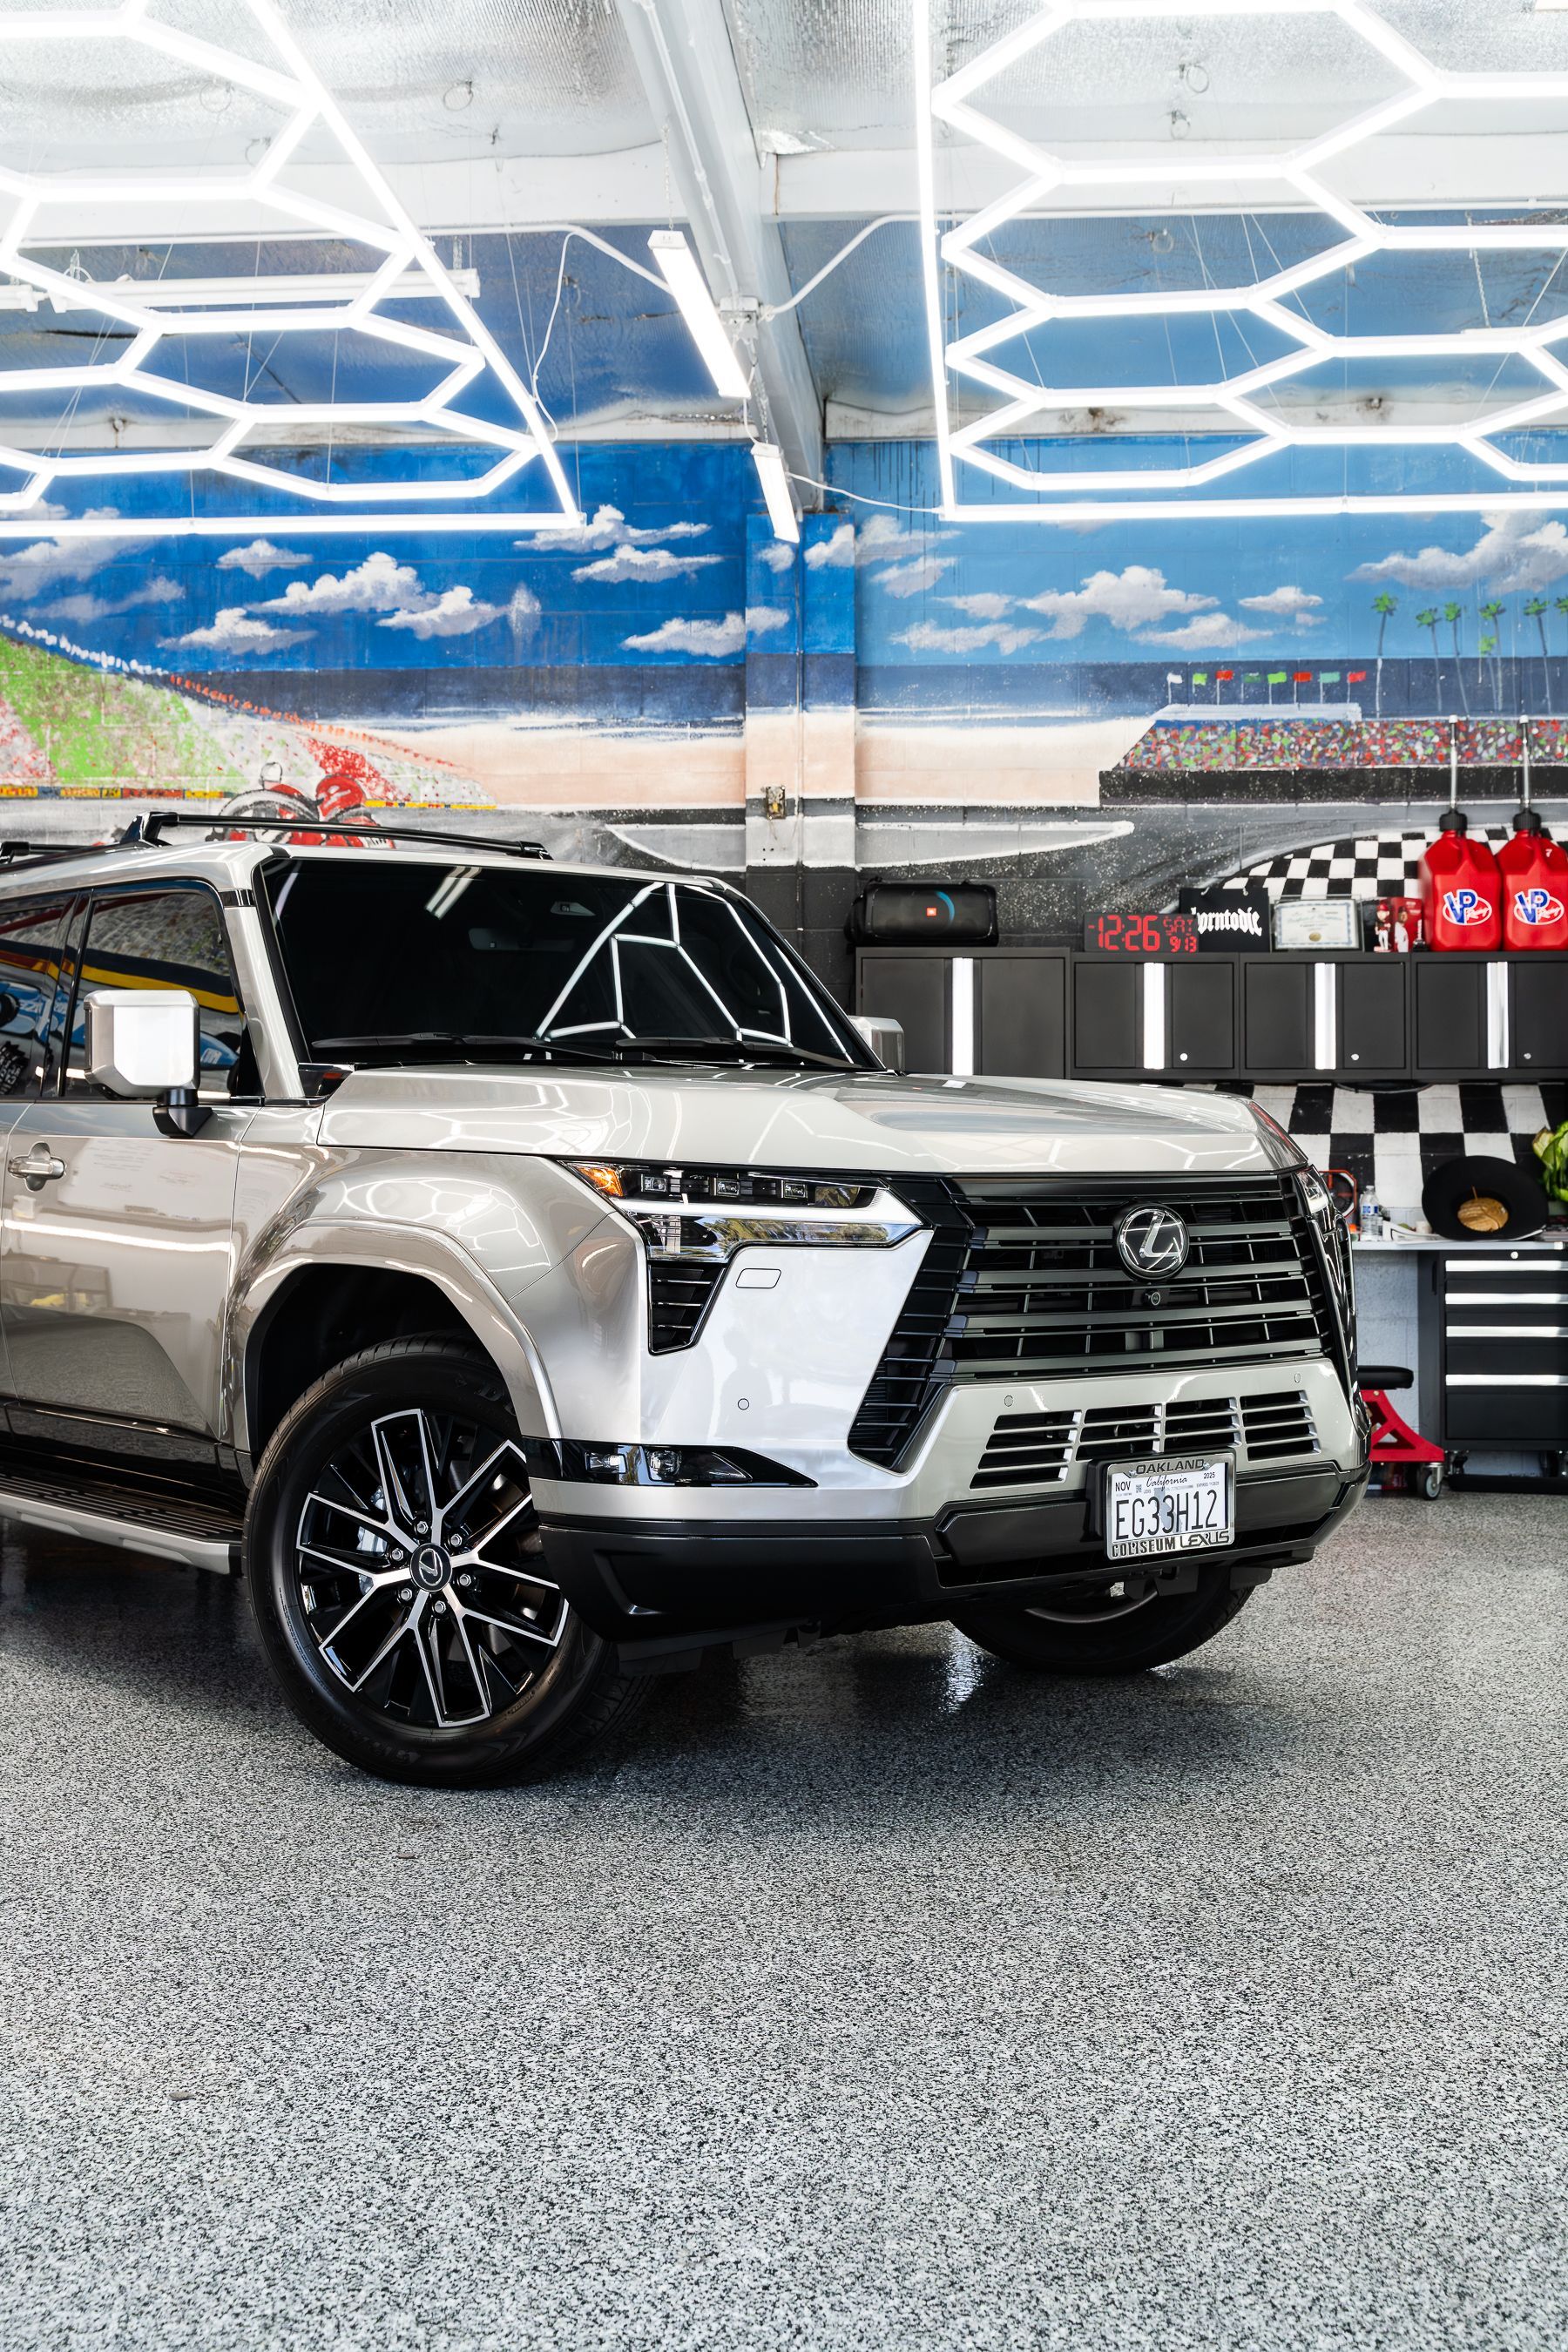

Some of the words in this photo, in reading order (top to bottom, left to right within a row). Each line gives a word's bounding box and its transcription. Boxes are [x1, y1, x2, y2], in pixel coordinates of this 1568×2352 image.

[1443, 889, 1477, 924] VP
[1515, 889, 1550, 924] VP
[1191, 907, 1262, 936] orntodie
[1136, 1458, 1205, 1475] OAKLAND
[1115, 1481, 1132, 1492] NOV
[1146, 1475, 1187, 1492] California
[1116, 1490, 1218, 1540] EG33H12
[1112, 1537, 1175, 1558] COLISEUM
[1180, 1531, 1229, 1549] LEXUS
